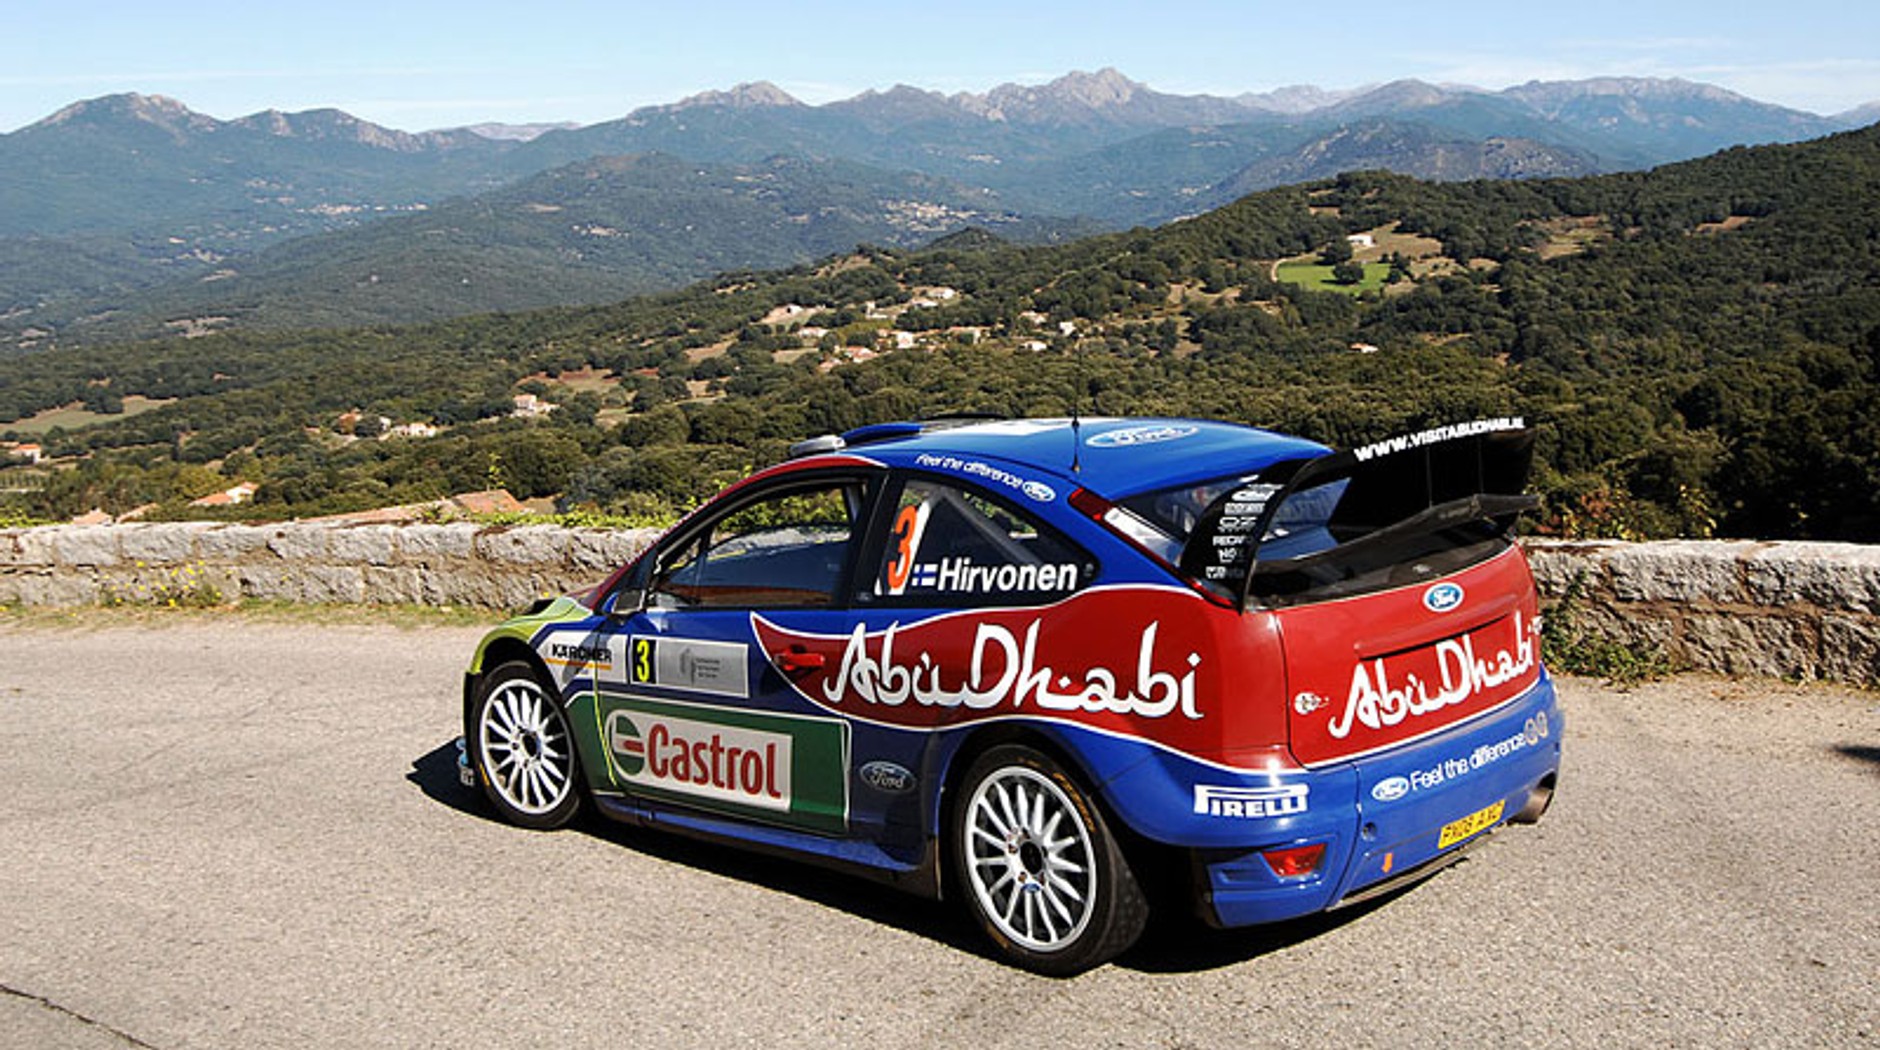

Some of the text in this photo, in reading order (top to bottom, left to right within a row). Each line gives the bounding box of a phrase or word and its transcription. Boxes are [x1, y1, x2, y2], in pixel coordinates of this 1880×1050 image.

[914, 453, 1024, 489] Feel the difference
[1024, 483, 1054, 501] Ford
[888, 504, 917, 589] 3
[937, 556, 1078, 592] Hirvonen
[636, 639, 650, 683] 3
[823, 618, 1204, 719] Abu Dhabi
[1328, 610, 1534, 738] Abu Dhabi
[648, 723, 782, 800] Castrol
[869, 766, 906, 789] Ford
[1374, 733, 1527, 799] Ford Feel the difference
[1194, 784, 1308, 818] PIRELLI
